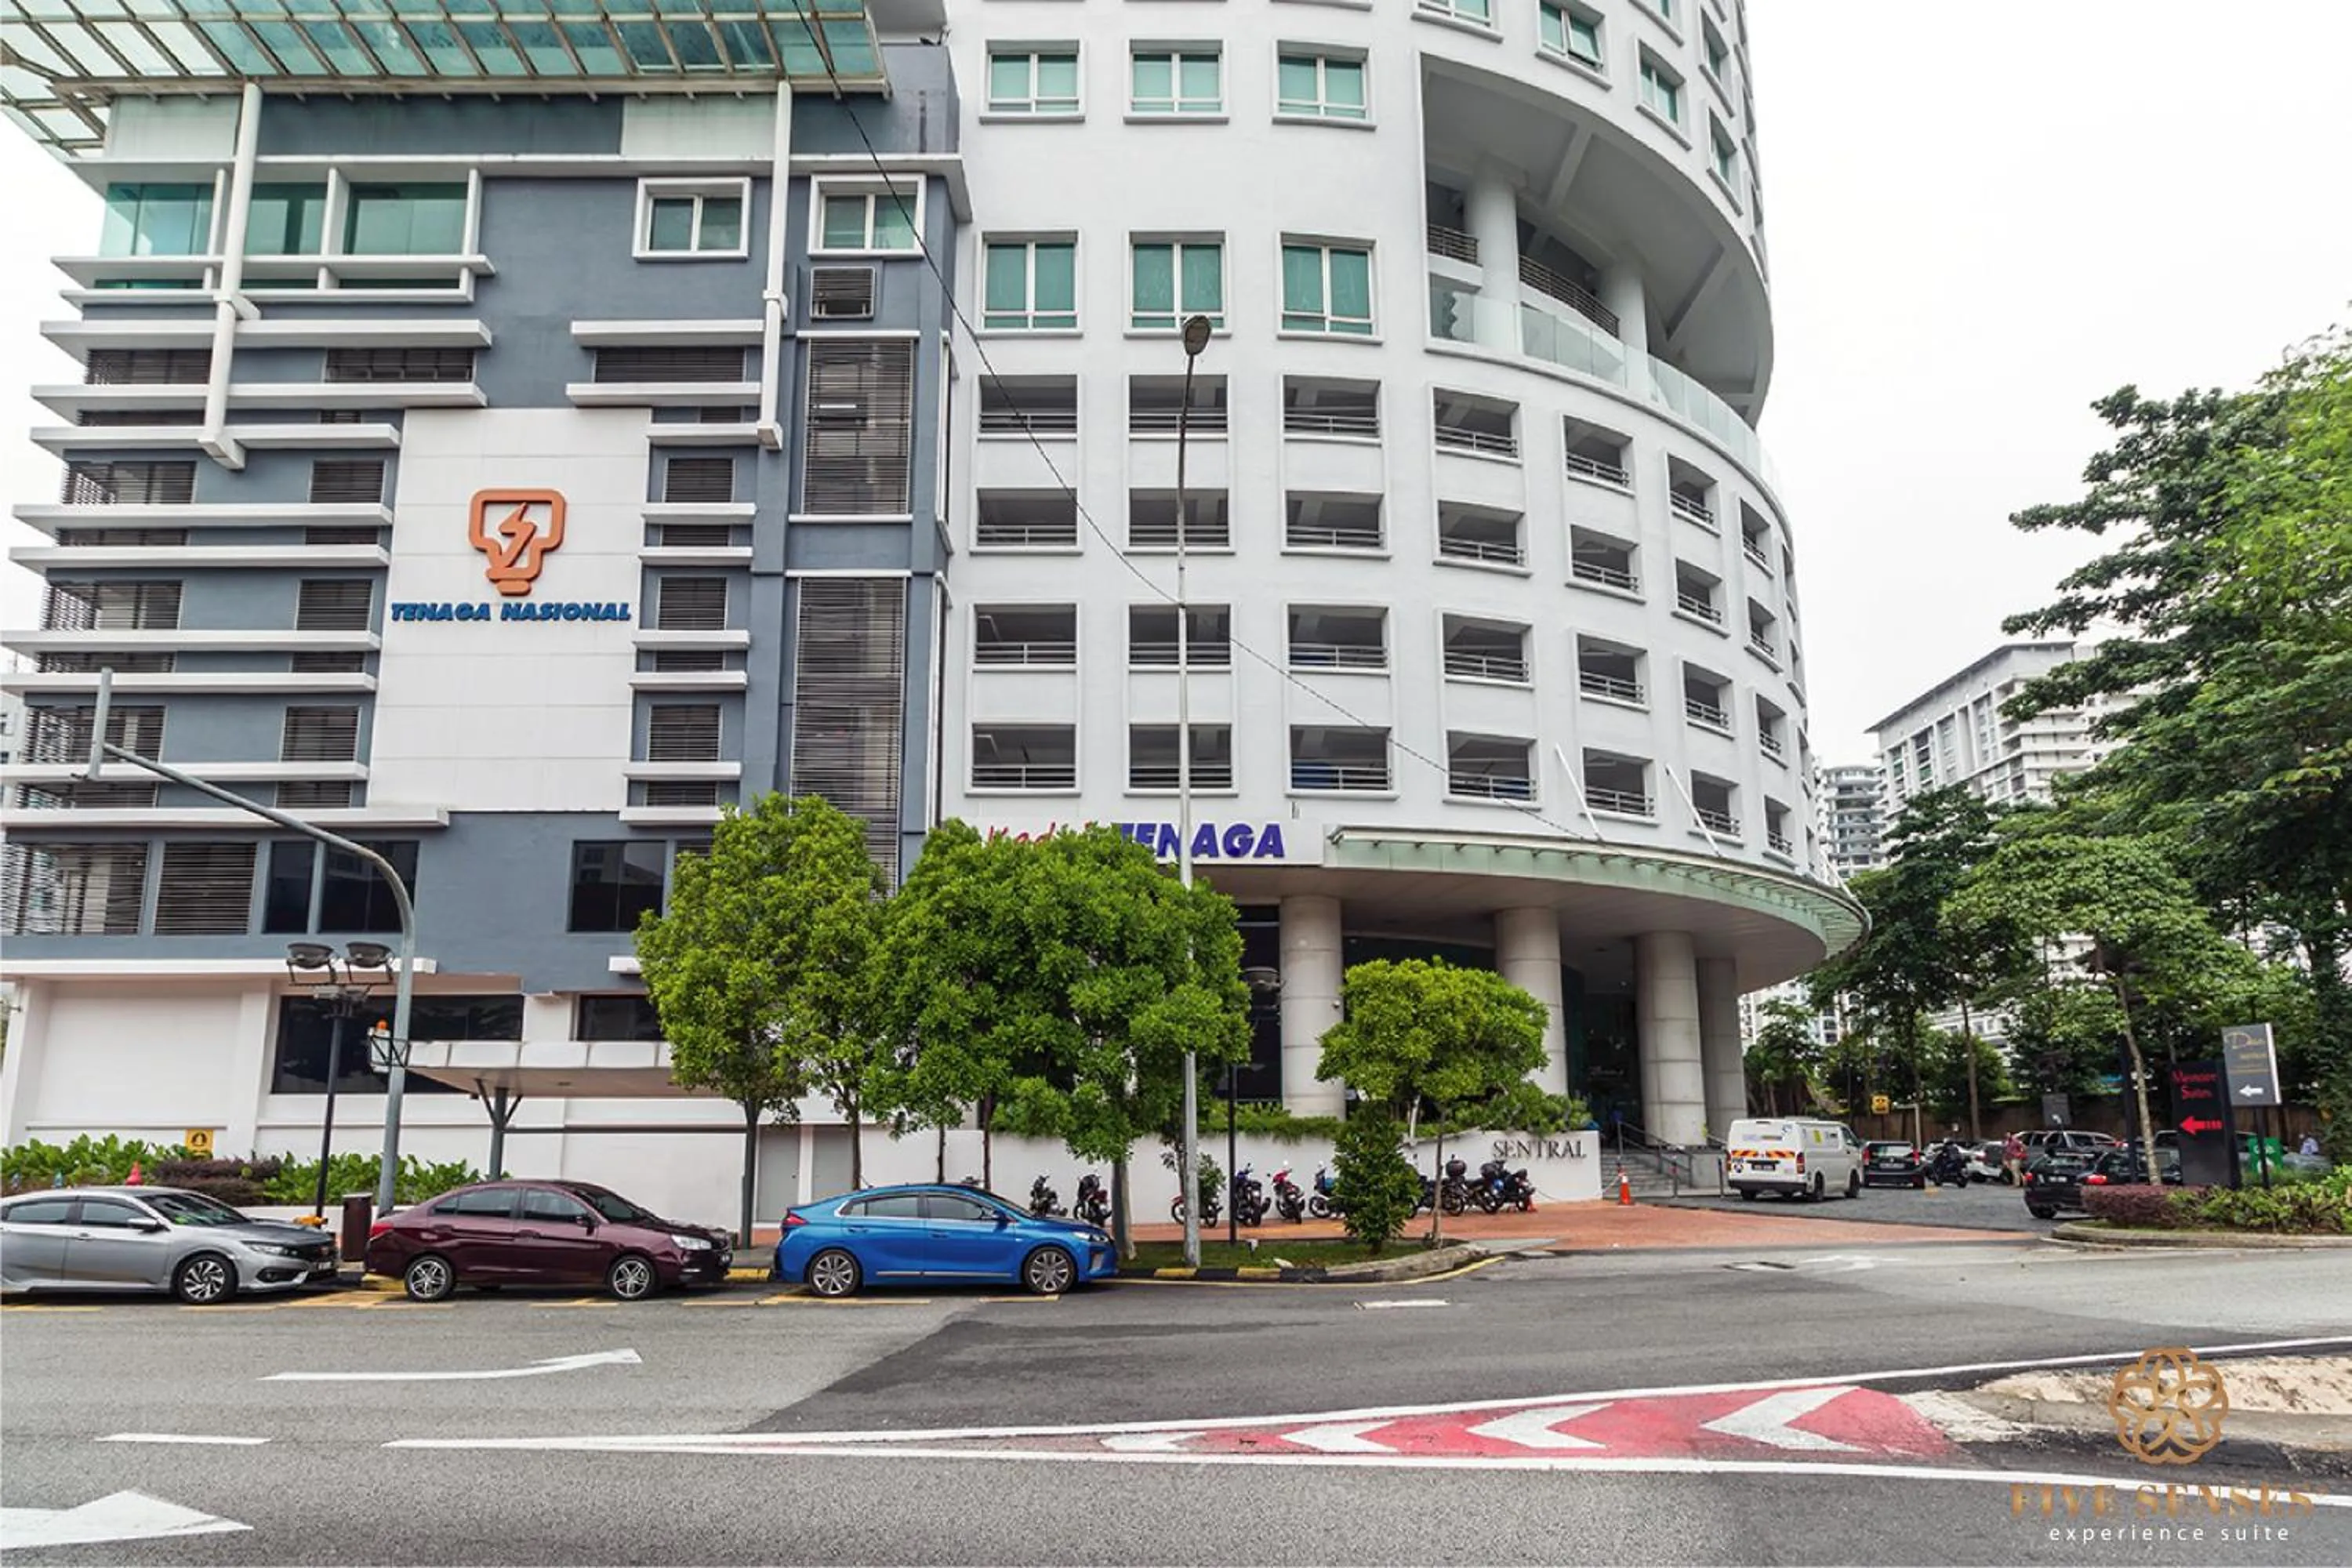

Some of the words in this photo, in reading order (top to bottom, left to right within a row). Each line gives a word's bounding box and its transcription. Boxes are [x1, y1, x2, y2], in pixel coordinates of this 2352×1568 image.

[391, 602, 492, 622] TENAGA
[499, 602, 632, 622] NASIONAL
[1493, 1140, 1588, 1158] SENTRAL
